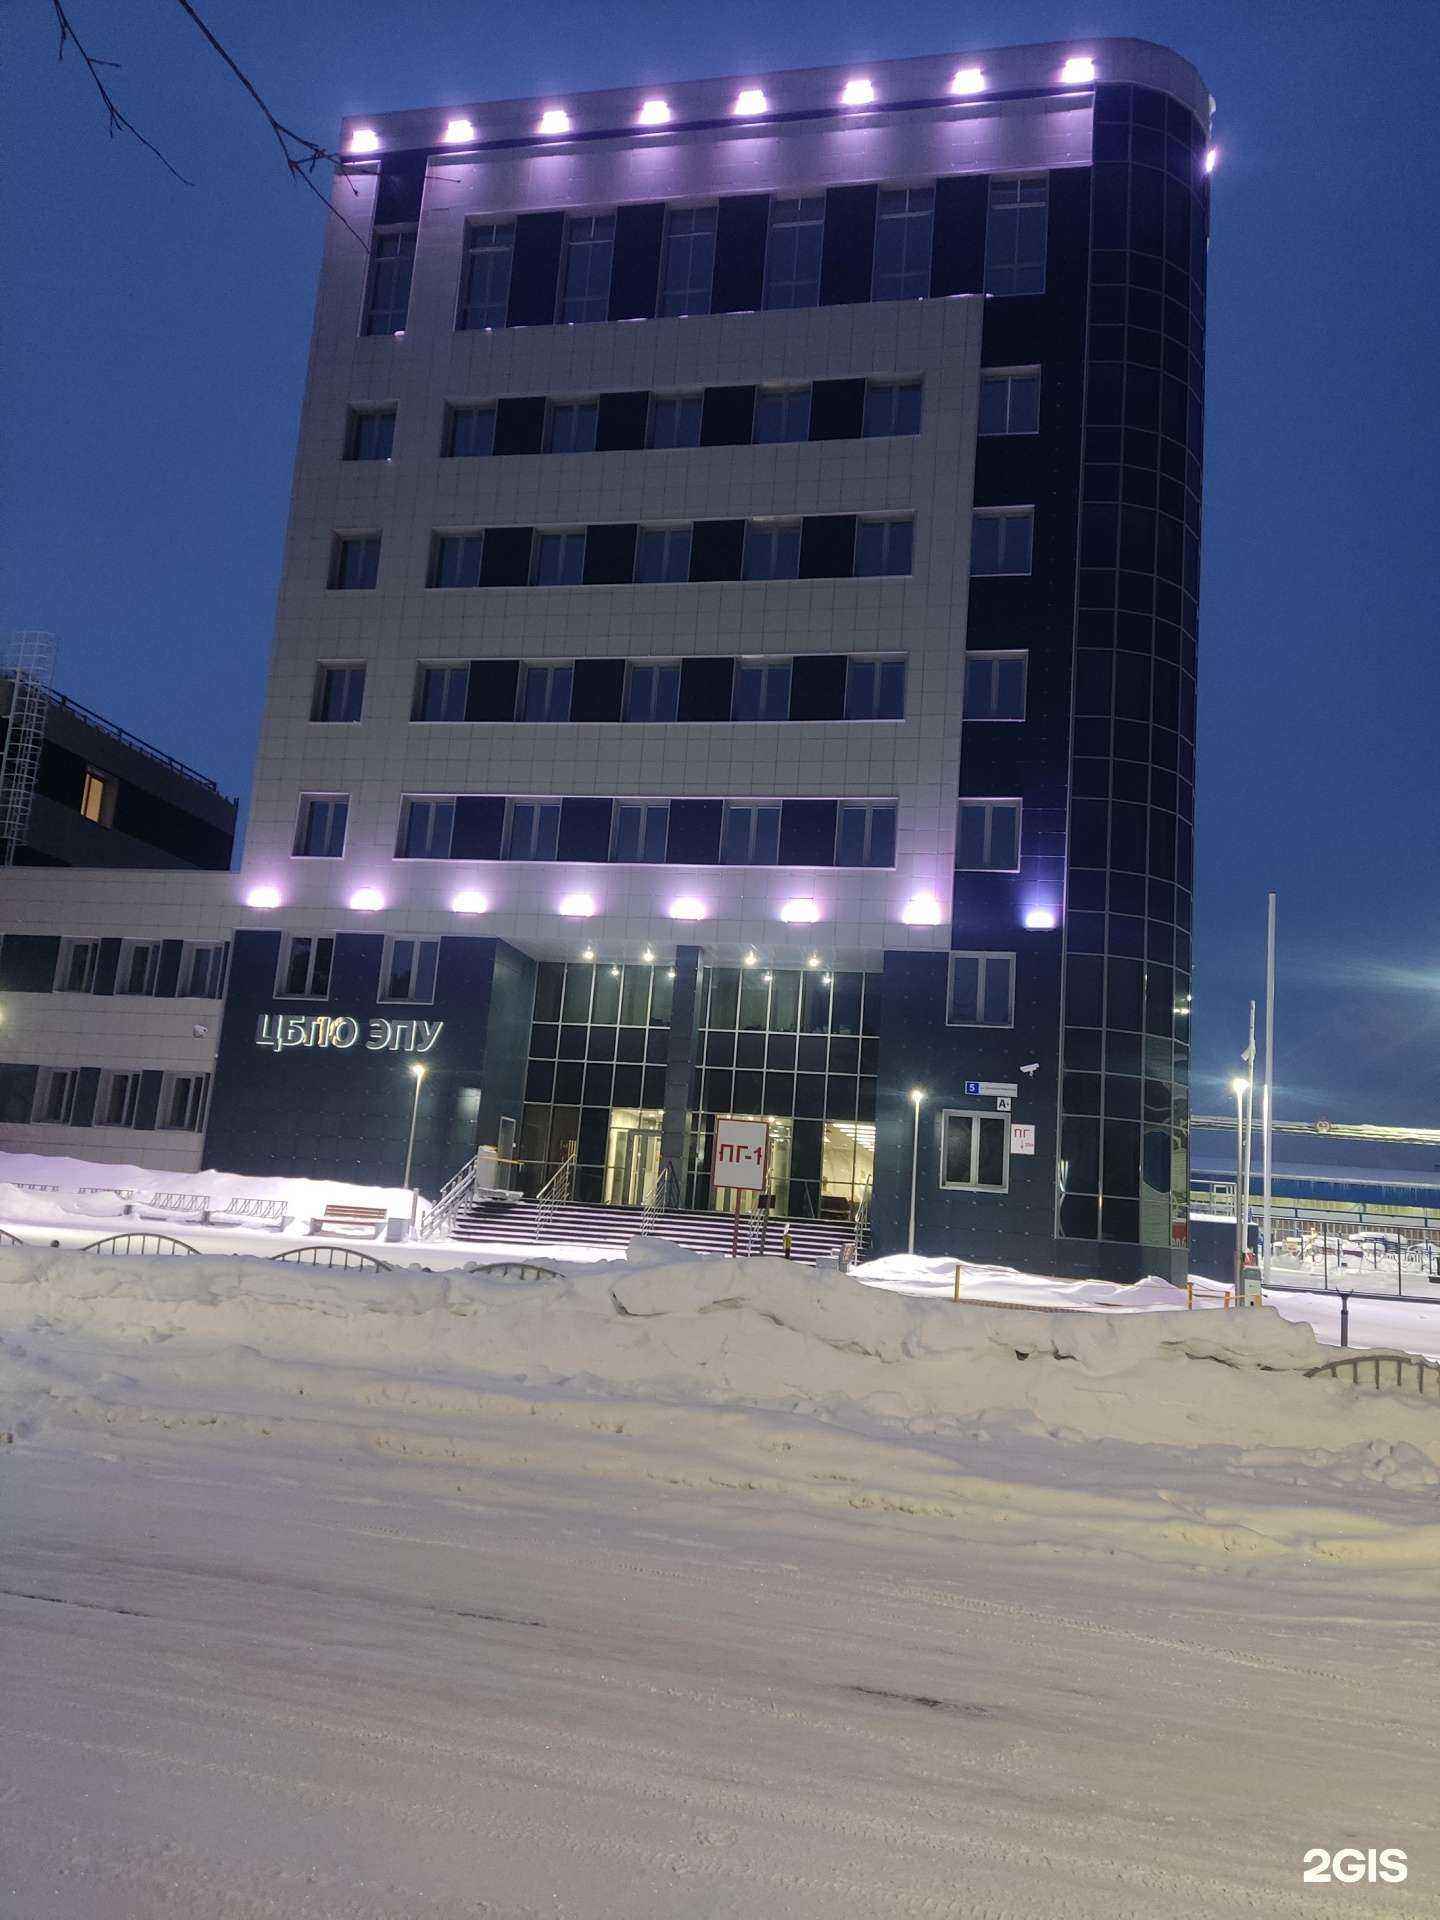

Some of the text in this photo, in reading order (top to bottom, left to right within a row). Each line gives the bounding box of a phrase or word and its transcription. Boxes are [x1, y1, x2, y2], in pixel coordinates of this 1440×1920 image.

[255, 1013, 444, 1052] ЦБПО ЭПУ
[969, 1083, 975, 1092] 5
[1014, 1128, 1032, 1138] ПГ
[718, 1143, 763, 1165] ПГ-1
